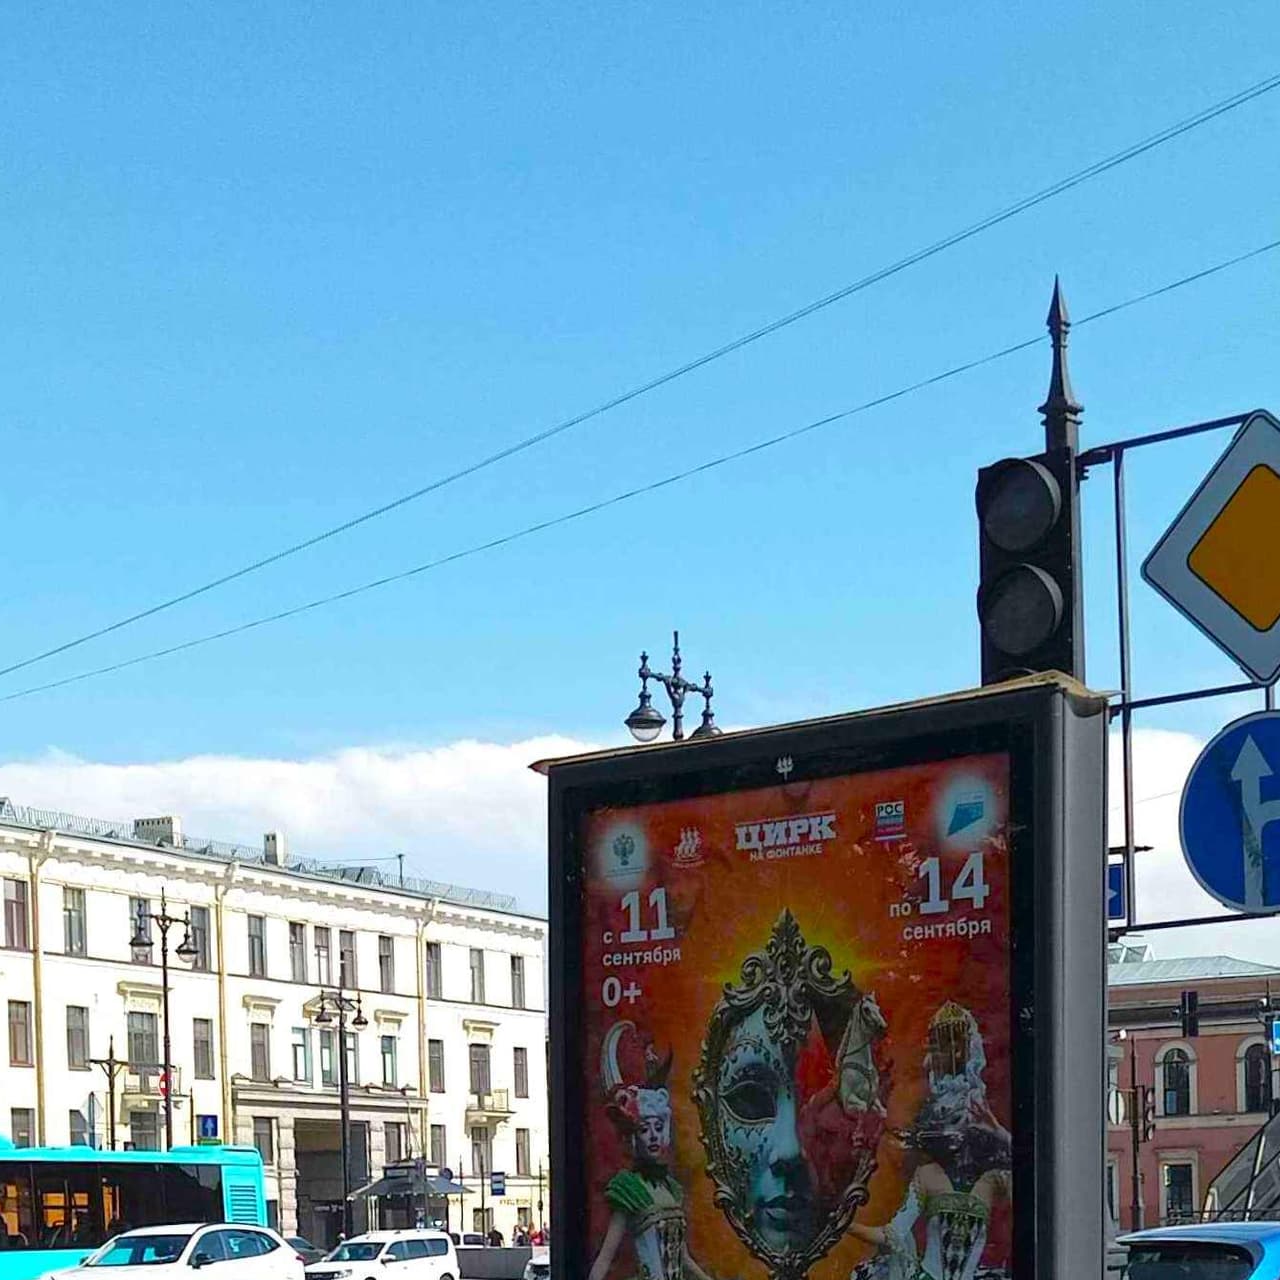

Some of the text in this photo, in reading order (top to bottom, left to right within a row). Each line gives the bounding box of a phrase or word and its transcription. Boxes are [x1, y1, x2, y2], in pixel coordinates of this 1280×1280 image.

[735, 814, 836, 850] ЦИРК
[750, 843, 823, 862] НА ФОНТАНКЕ
[889, 852, 990, 917] по 14
[603, 887, 675, 944] с 11
[903, 917, 992, 940] сентября
[602, 946, 681, 967] сентября
[602, 976, 642, 1008] 0+
